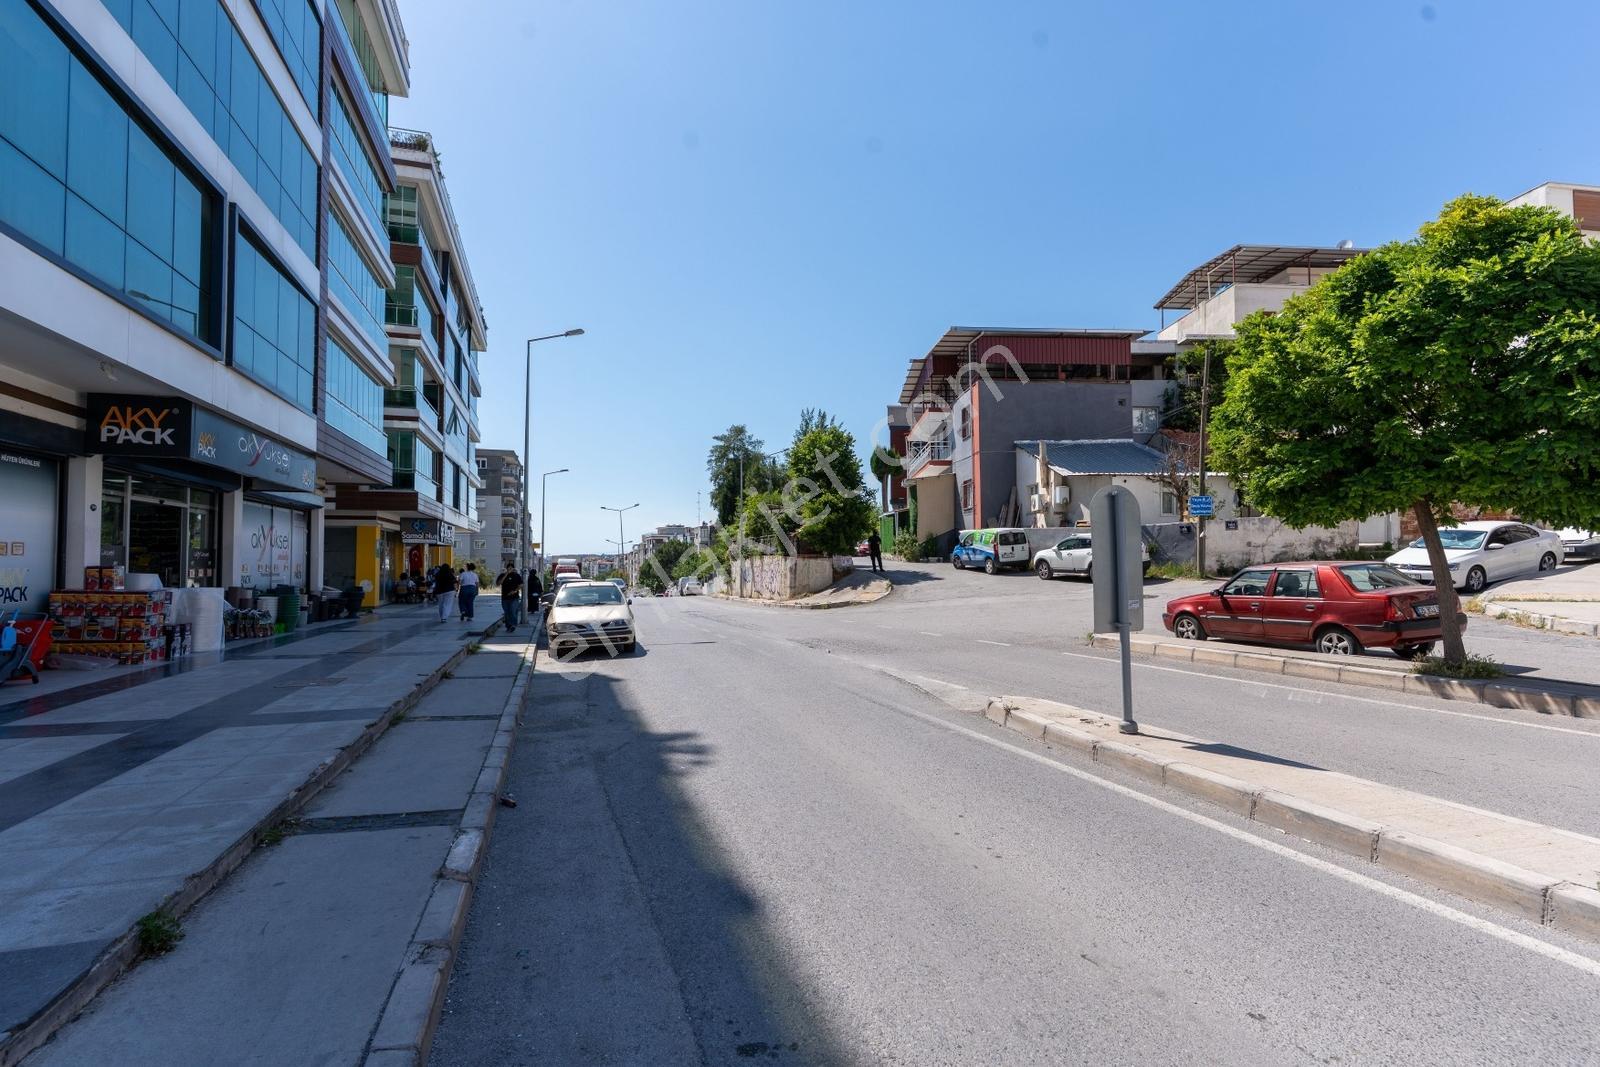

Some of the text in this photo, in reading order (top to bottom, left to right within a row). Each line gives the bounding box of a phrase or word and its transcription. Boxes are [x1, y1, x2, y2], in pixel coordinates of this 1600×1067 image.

[100, 405, 171, 429] AKY
[100, 425, 175, 446] PACK
[197, 442, 216, 459] PACK
